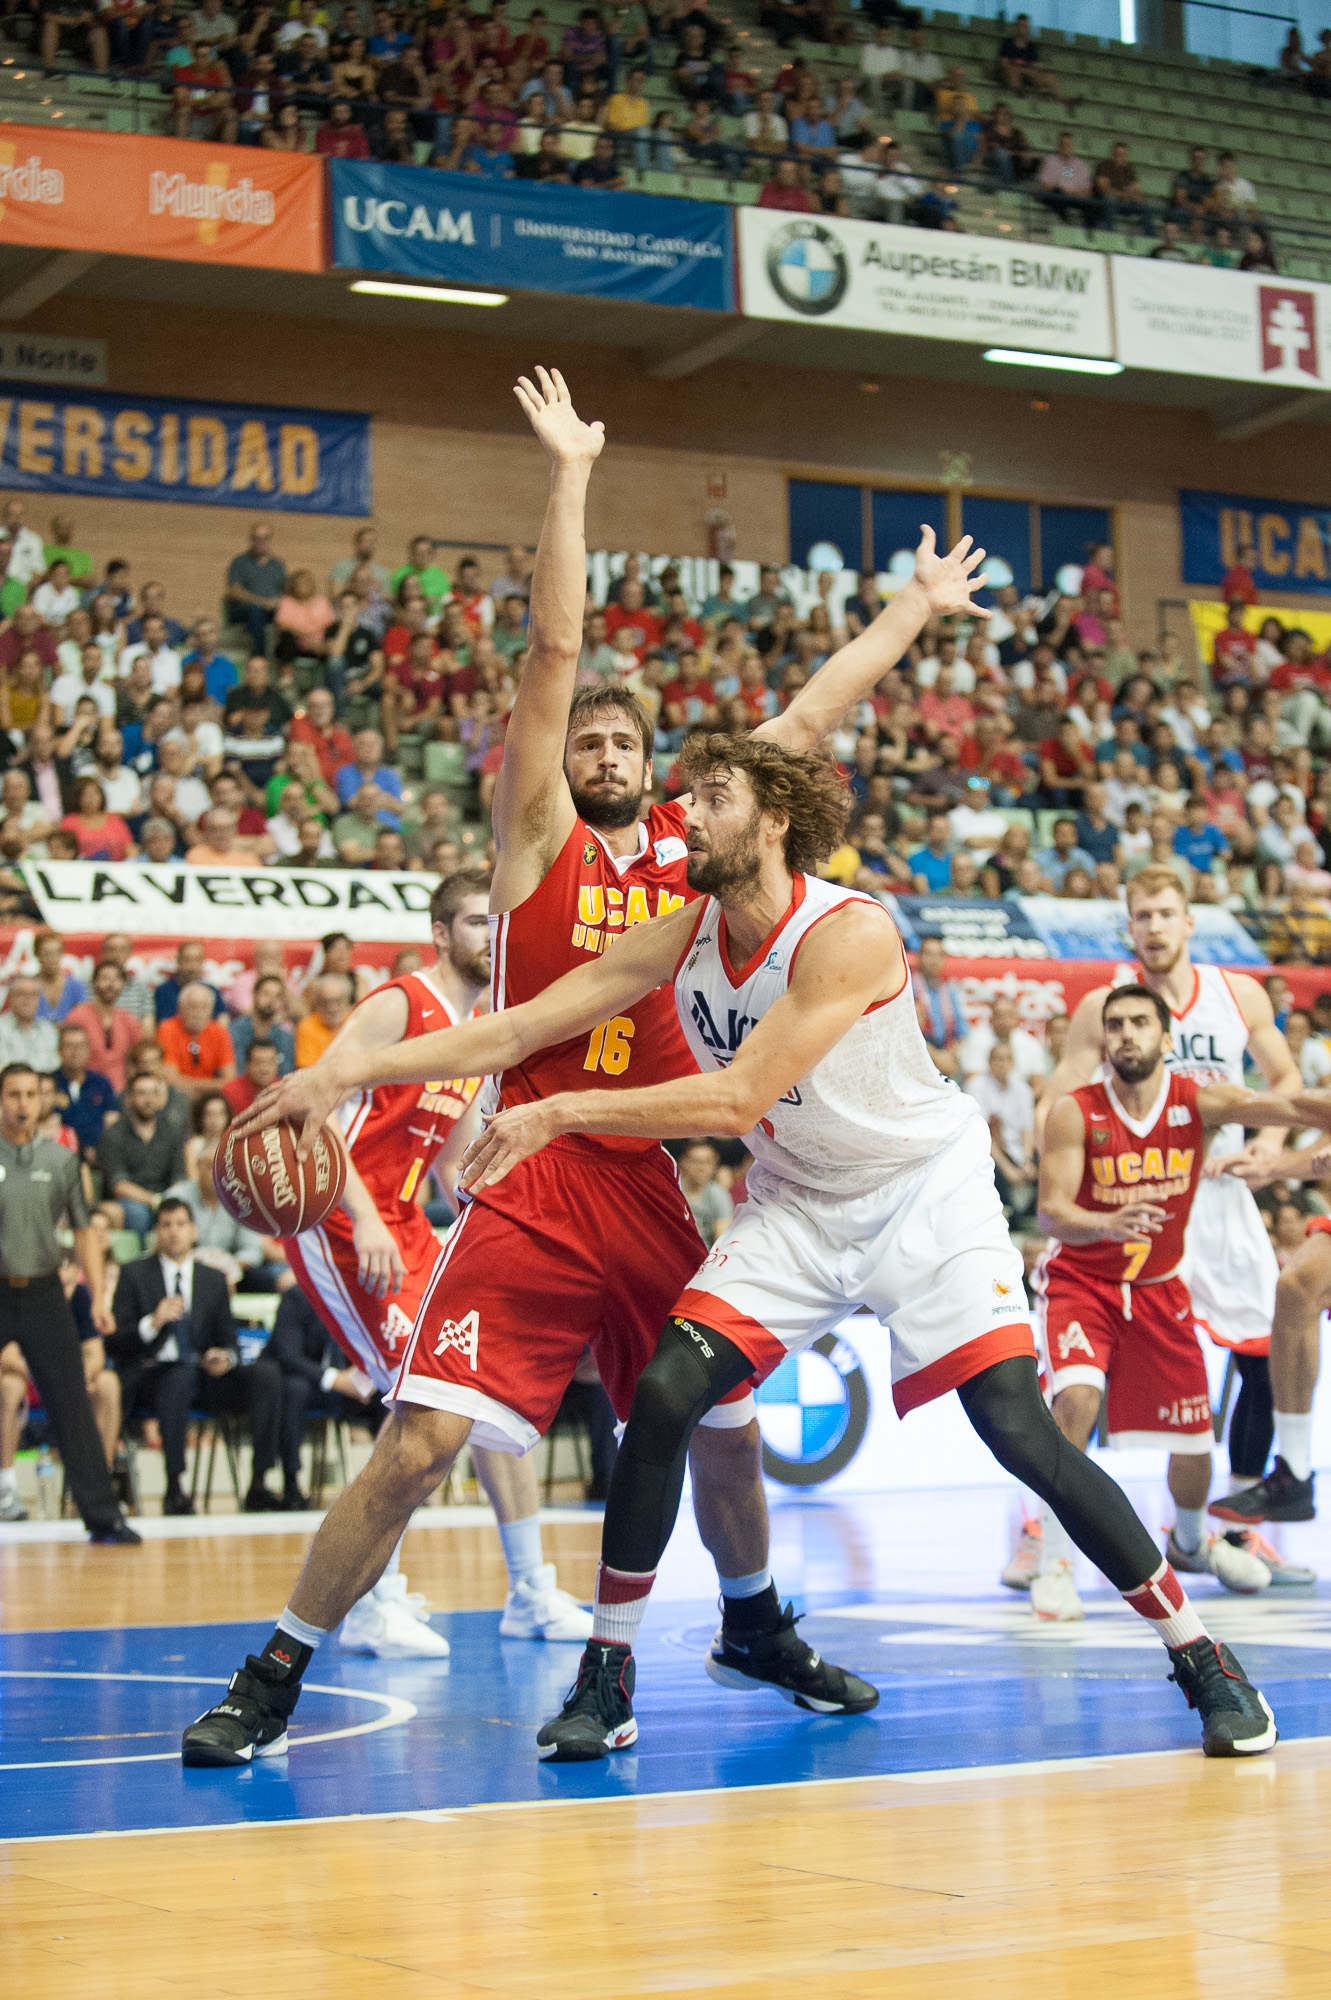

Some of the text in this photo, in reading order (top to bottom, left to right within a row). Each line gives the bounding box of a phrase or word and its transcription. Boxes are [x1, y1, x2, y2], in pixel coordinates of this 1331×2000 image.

[149, 169, 275, 226] Murcia
[343, 196, 476, 246] UCAM
[863, 240, 1091, 296] Aupesán BMW
[15, 344, 97, 374] Norte
[1218, 508, 1329, 580] UCA
[578, 884, 685, 926] UCAM
[583, 1016, 635, 1075] 16
[261, 1126, 298, 1209] SPALDIN
[398, 1157, 424, 1202] 1
[1091, 1147, 1195, 1187] UCAM
[1123, 1242, 1152, 1281] 7
[680, 1321, 715, 1359] SKINS
